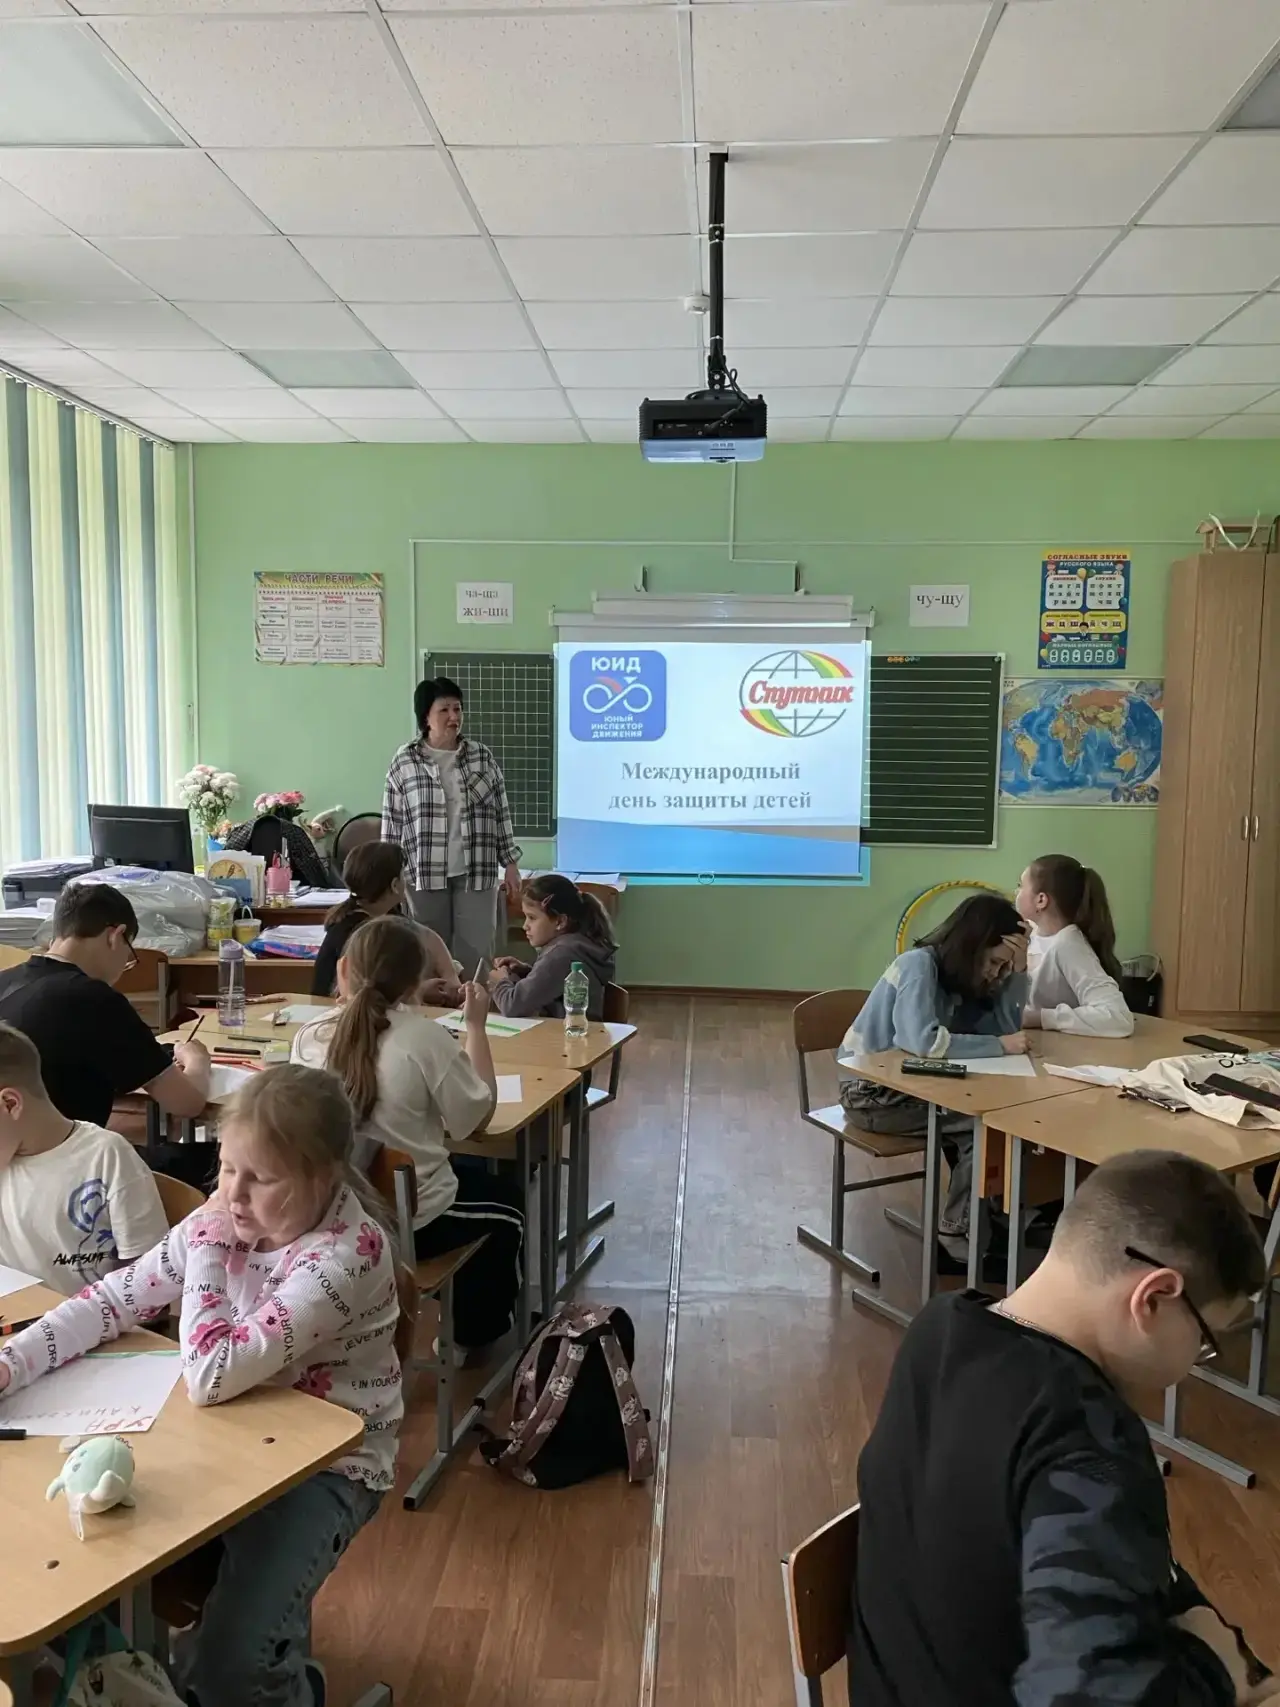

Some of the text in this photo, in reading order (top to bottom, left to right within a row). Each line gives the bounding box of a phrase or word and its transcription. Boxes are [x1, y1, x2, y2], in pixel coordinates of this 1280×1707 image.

[284, 574, 354, 584] ЧАСТИ РЕЧИ
[592, 657, 641, 673] ЮИД
[750, 680, 854, 710] Спутник
[591, 722, 644, 731] ИНСПЕКТОР
[604, 714, 634, 723] ЮНЫЙ
[592, 730, 643, 739] ДВИЖЕНИЯ
[621, 762, 800, 784] Международный
[608, 791, 811, 810] день защиты детей
[317, 1271, 340, 1303] YOUR
[280, 1317, 294, 1352] YOUR
